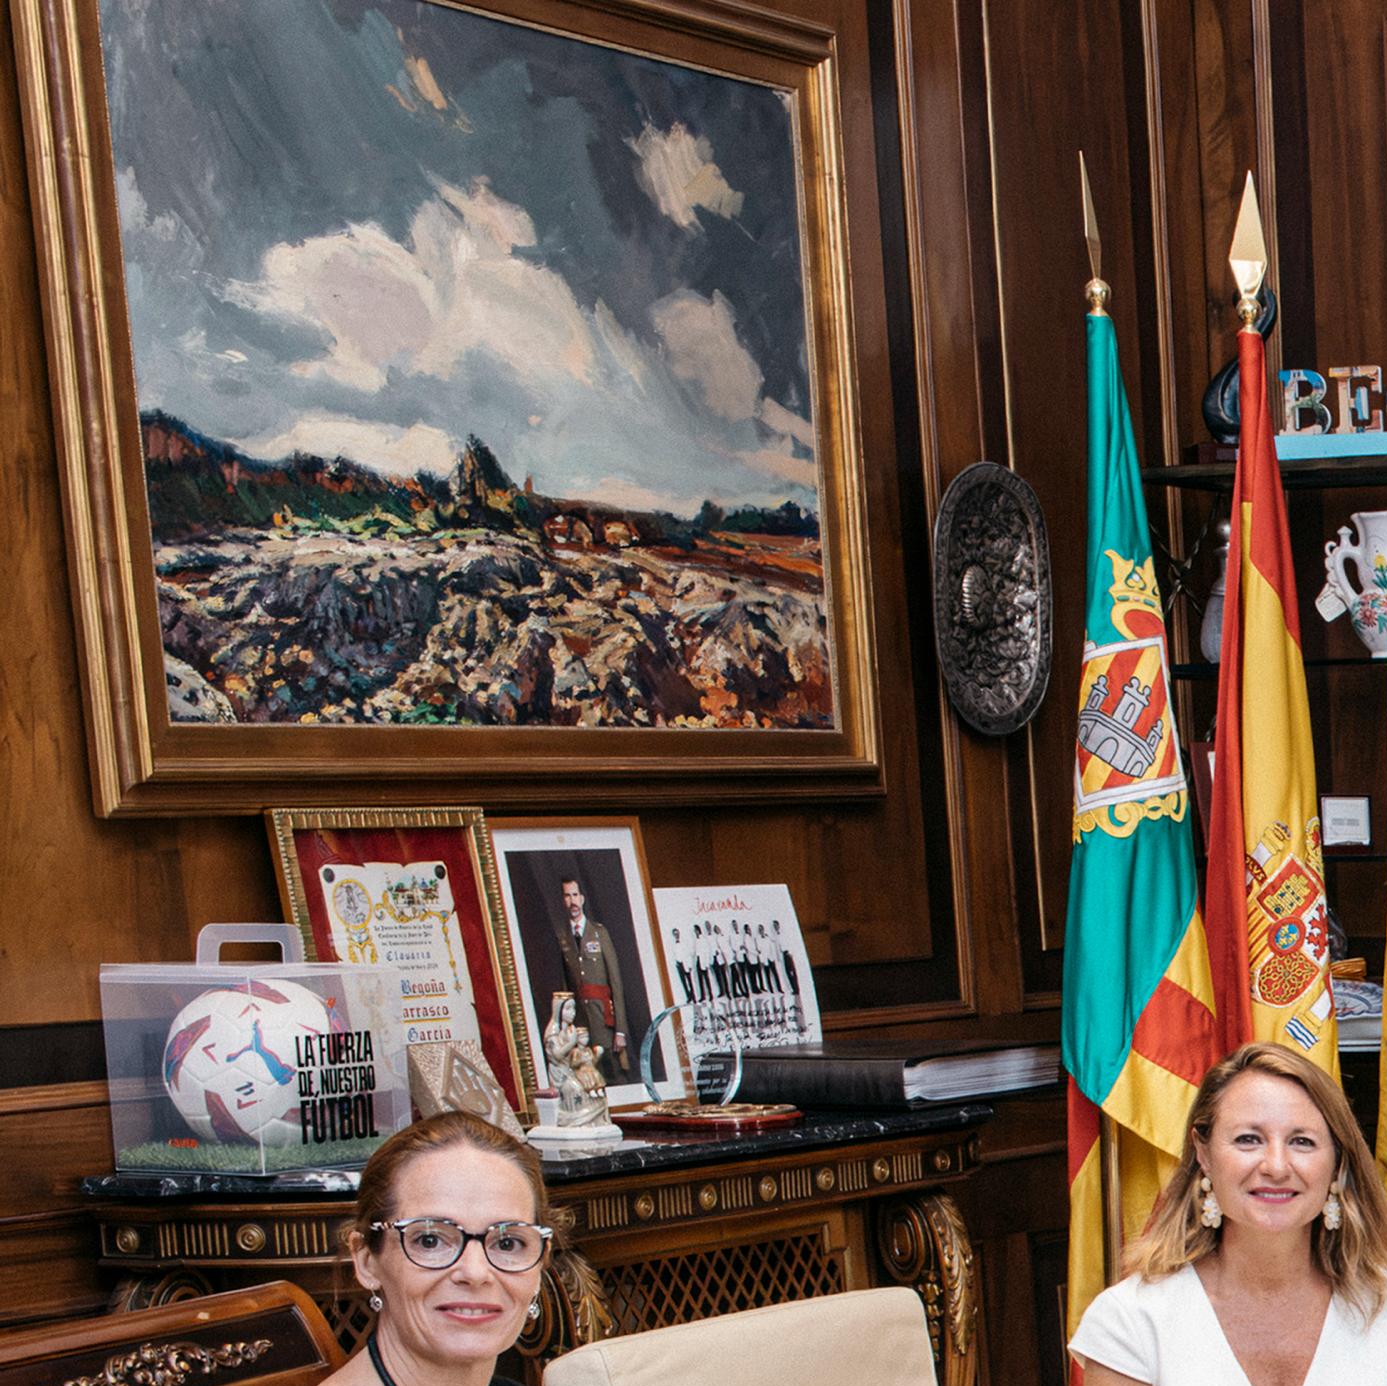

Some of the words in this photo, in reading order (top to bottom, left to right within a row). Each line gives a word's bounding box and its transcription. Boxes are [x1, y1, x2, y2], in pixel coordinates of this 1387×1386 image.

[400, 979, 446, 995] Begoña
[402, 1005, 449, 1019] arrasco
[295, 1035, 316, 1067] LA
[318, 1030, 374, 1067] FUERZA
[298, 1070, 314, 1097] DE
[320, 1065, 376, 1095] NUESTRO
